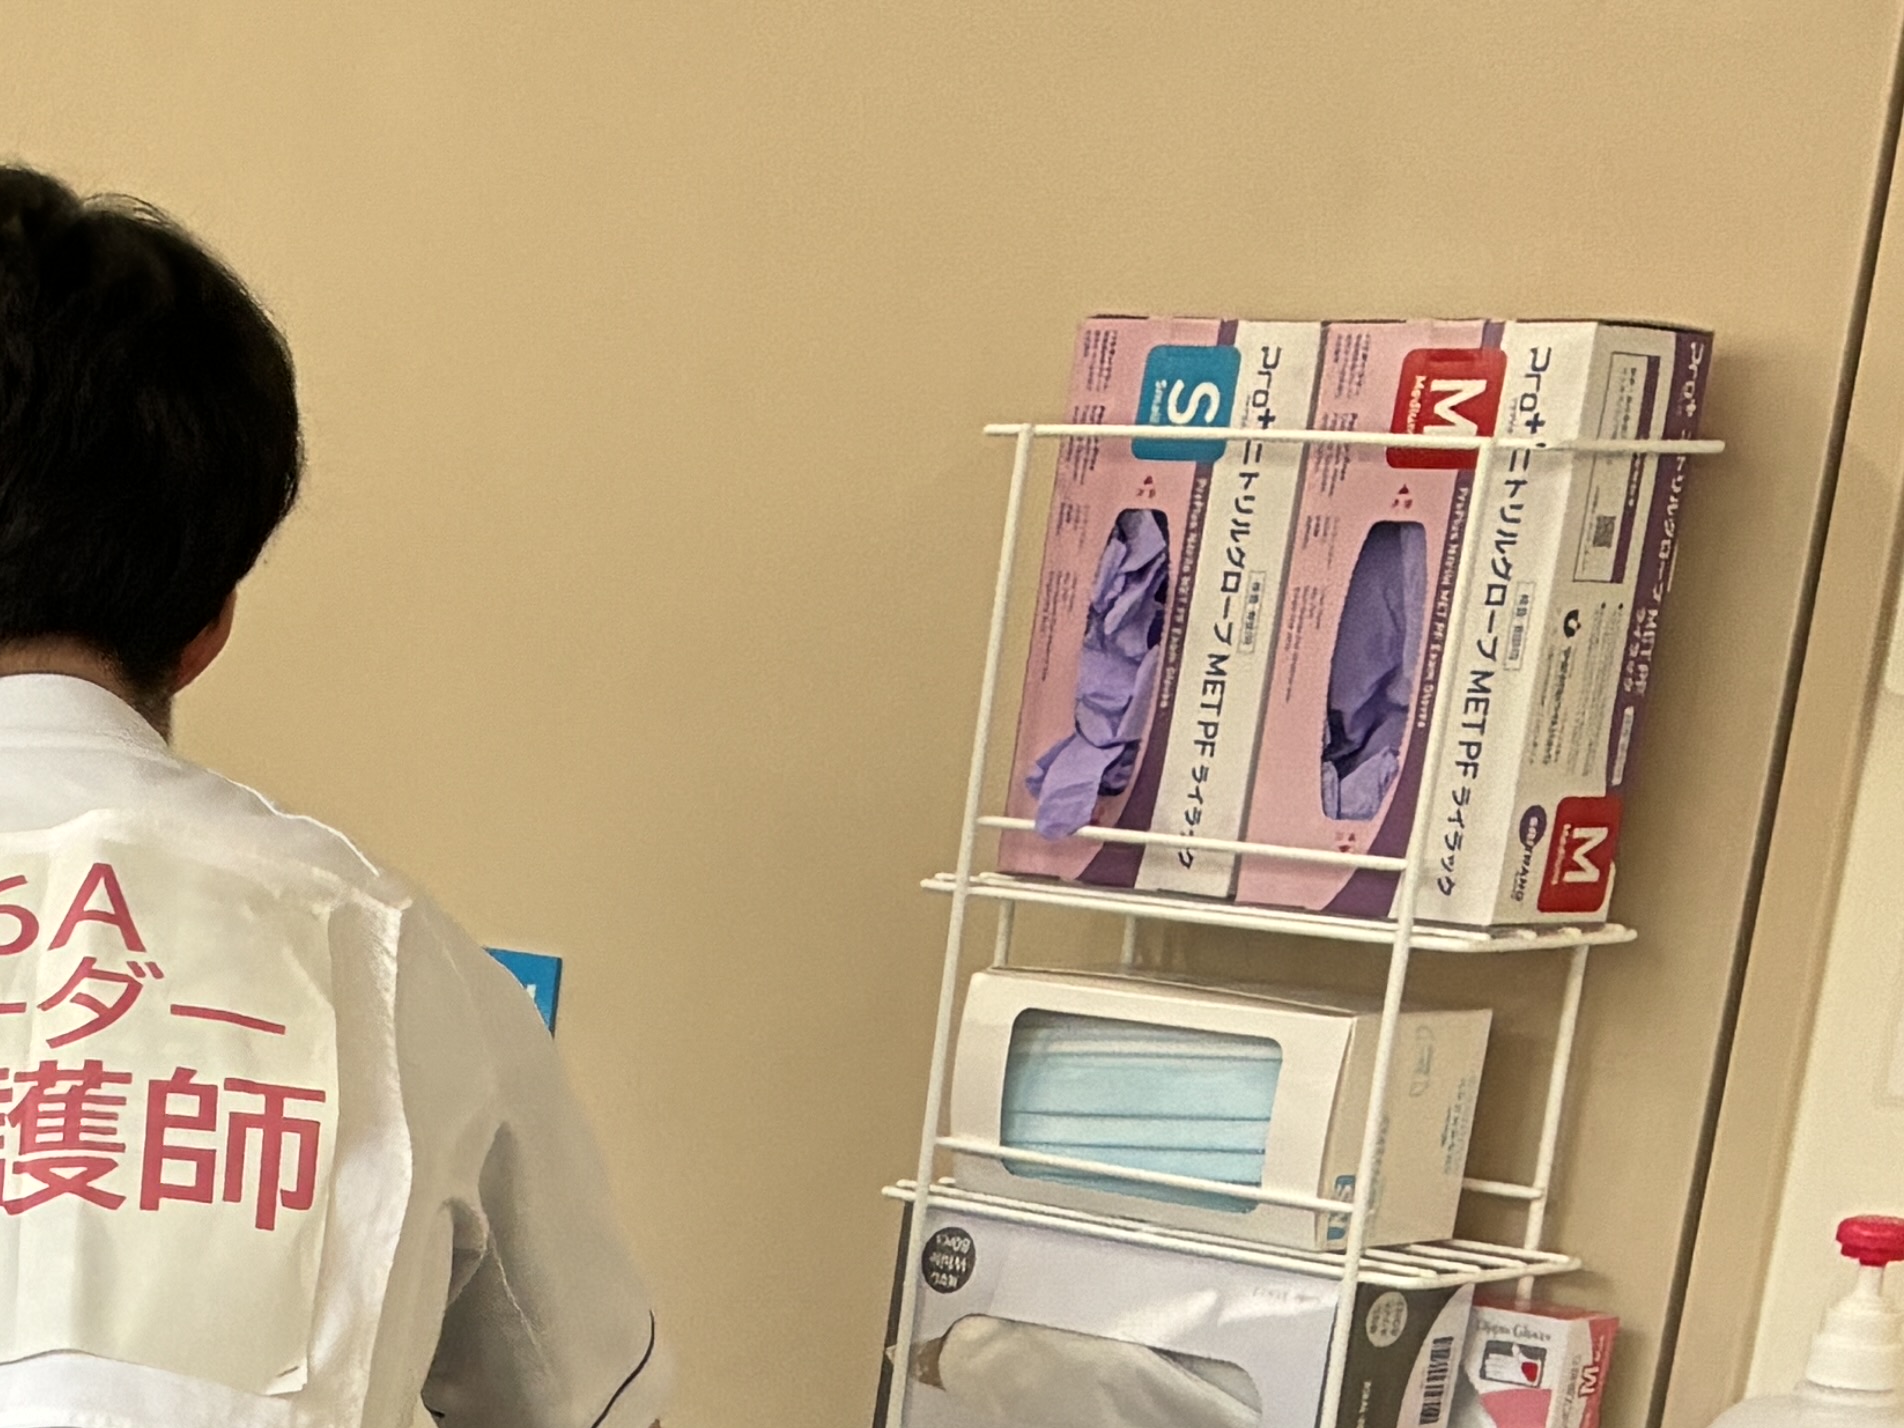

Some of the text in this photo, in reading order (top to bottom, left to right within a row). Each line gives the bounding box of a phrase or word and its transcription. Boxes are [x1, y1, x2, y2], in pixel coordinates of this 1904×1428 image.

[1167, 379, 1220, 424] S
[1423, 379, 1488, 436] M
[1200, 654, 1230, 716] MET
[1461, 670, 1495, 737] MET
[1194, 721, 1219, 758] PF
[1455, 741, 1482, 779] PF
[1437, 786, 1471, 896] ライラック
[1562, 827, 1609, 882] M
